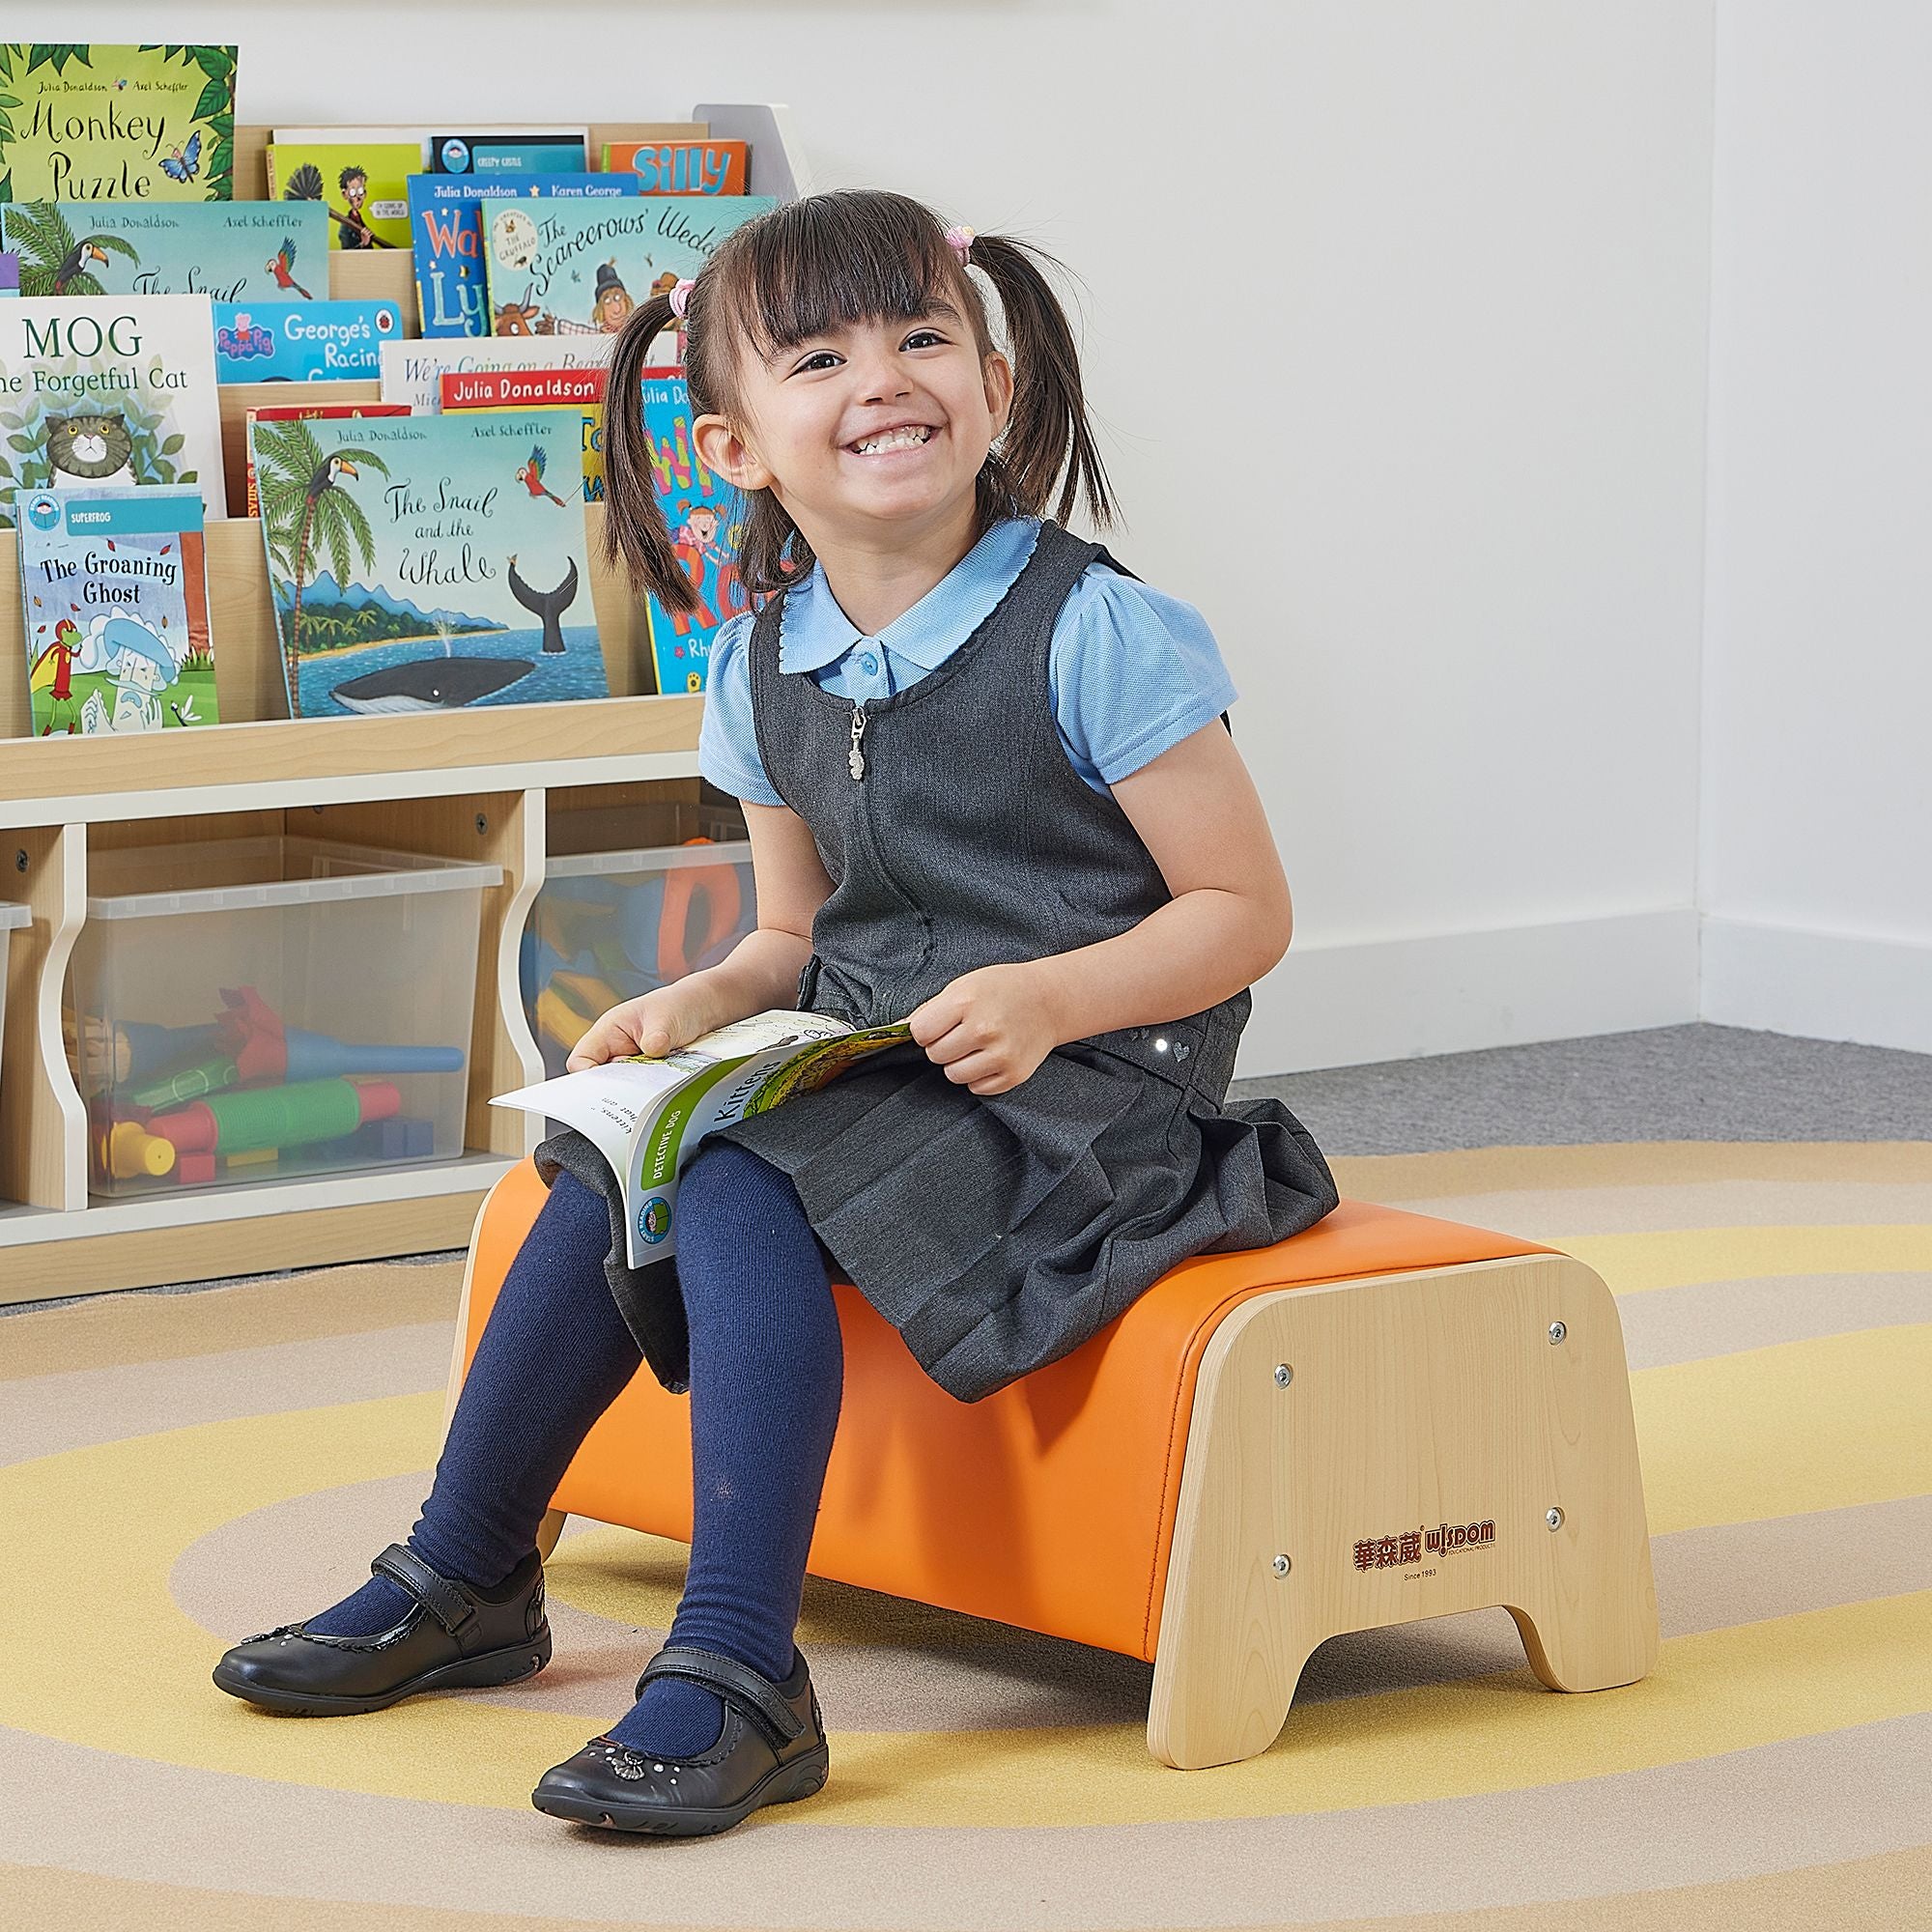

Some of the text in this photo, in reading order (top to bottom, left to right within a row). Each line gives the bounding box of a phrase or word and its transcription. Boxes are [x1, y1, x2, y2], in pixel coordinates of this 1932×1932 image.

[38, 80, 189, 95] Julia Donaldson Axel Scheffler
[19, 99, 166, 160] Monkey
[47, 151, 151, 203] Puzzle
[632, 145, 732, 196] Silly
[434, 185, 622, 198] Julia Donaldson Karen George
[90, 213, 302, 230] Julia Donaldson Axel Scheffler
[538, 213, 567, 248] The
[21, 316, 143, 358] MOG
[284, 313, 371, 347] George's
[33, 366, 139, 397] Forgetful
[149, 367, 188, 388] Cat
[453, 378, 594, 402] Julia Donaldson
[641, 386, 668, 404] ulia
[338, 422, 552, 443] Julia Donaldson Axel Scheffler
[384, 476, 498, 524] The Snail
[71, 512, 111, 524] SUPERFROG
[414, 519, 473, 538] and the
[40, 551, 177, 585] The Groaning
[399, 543, 497, 585] Whale
[83, 581, 140, 604] Ghost
[714, 1061, 781, 1122] Kittens
[653, 1110, 682, 1179] DETECTIVE DOG
[639, 1201, 653, 1230] READING
[1404, 1568, 1436, 1580] Since 1993
